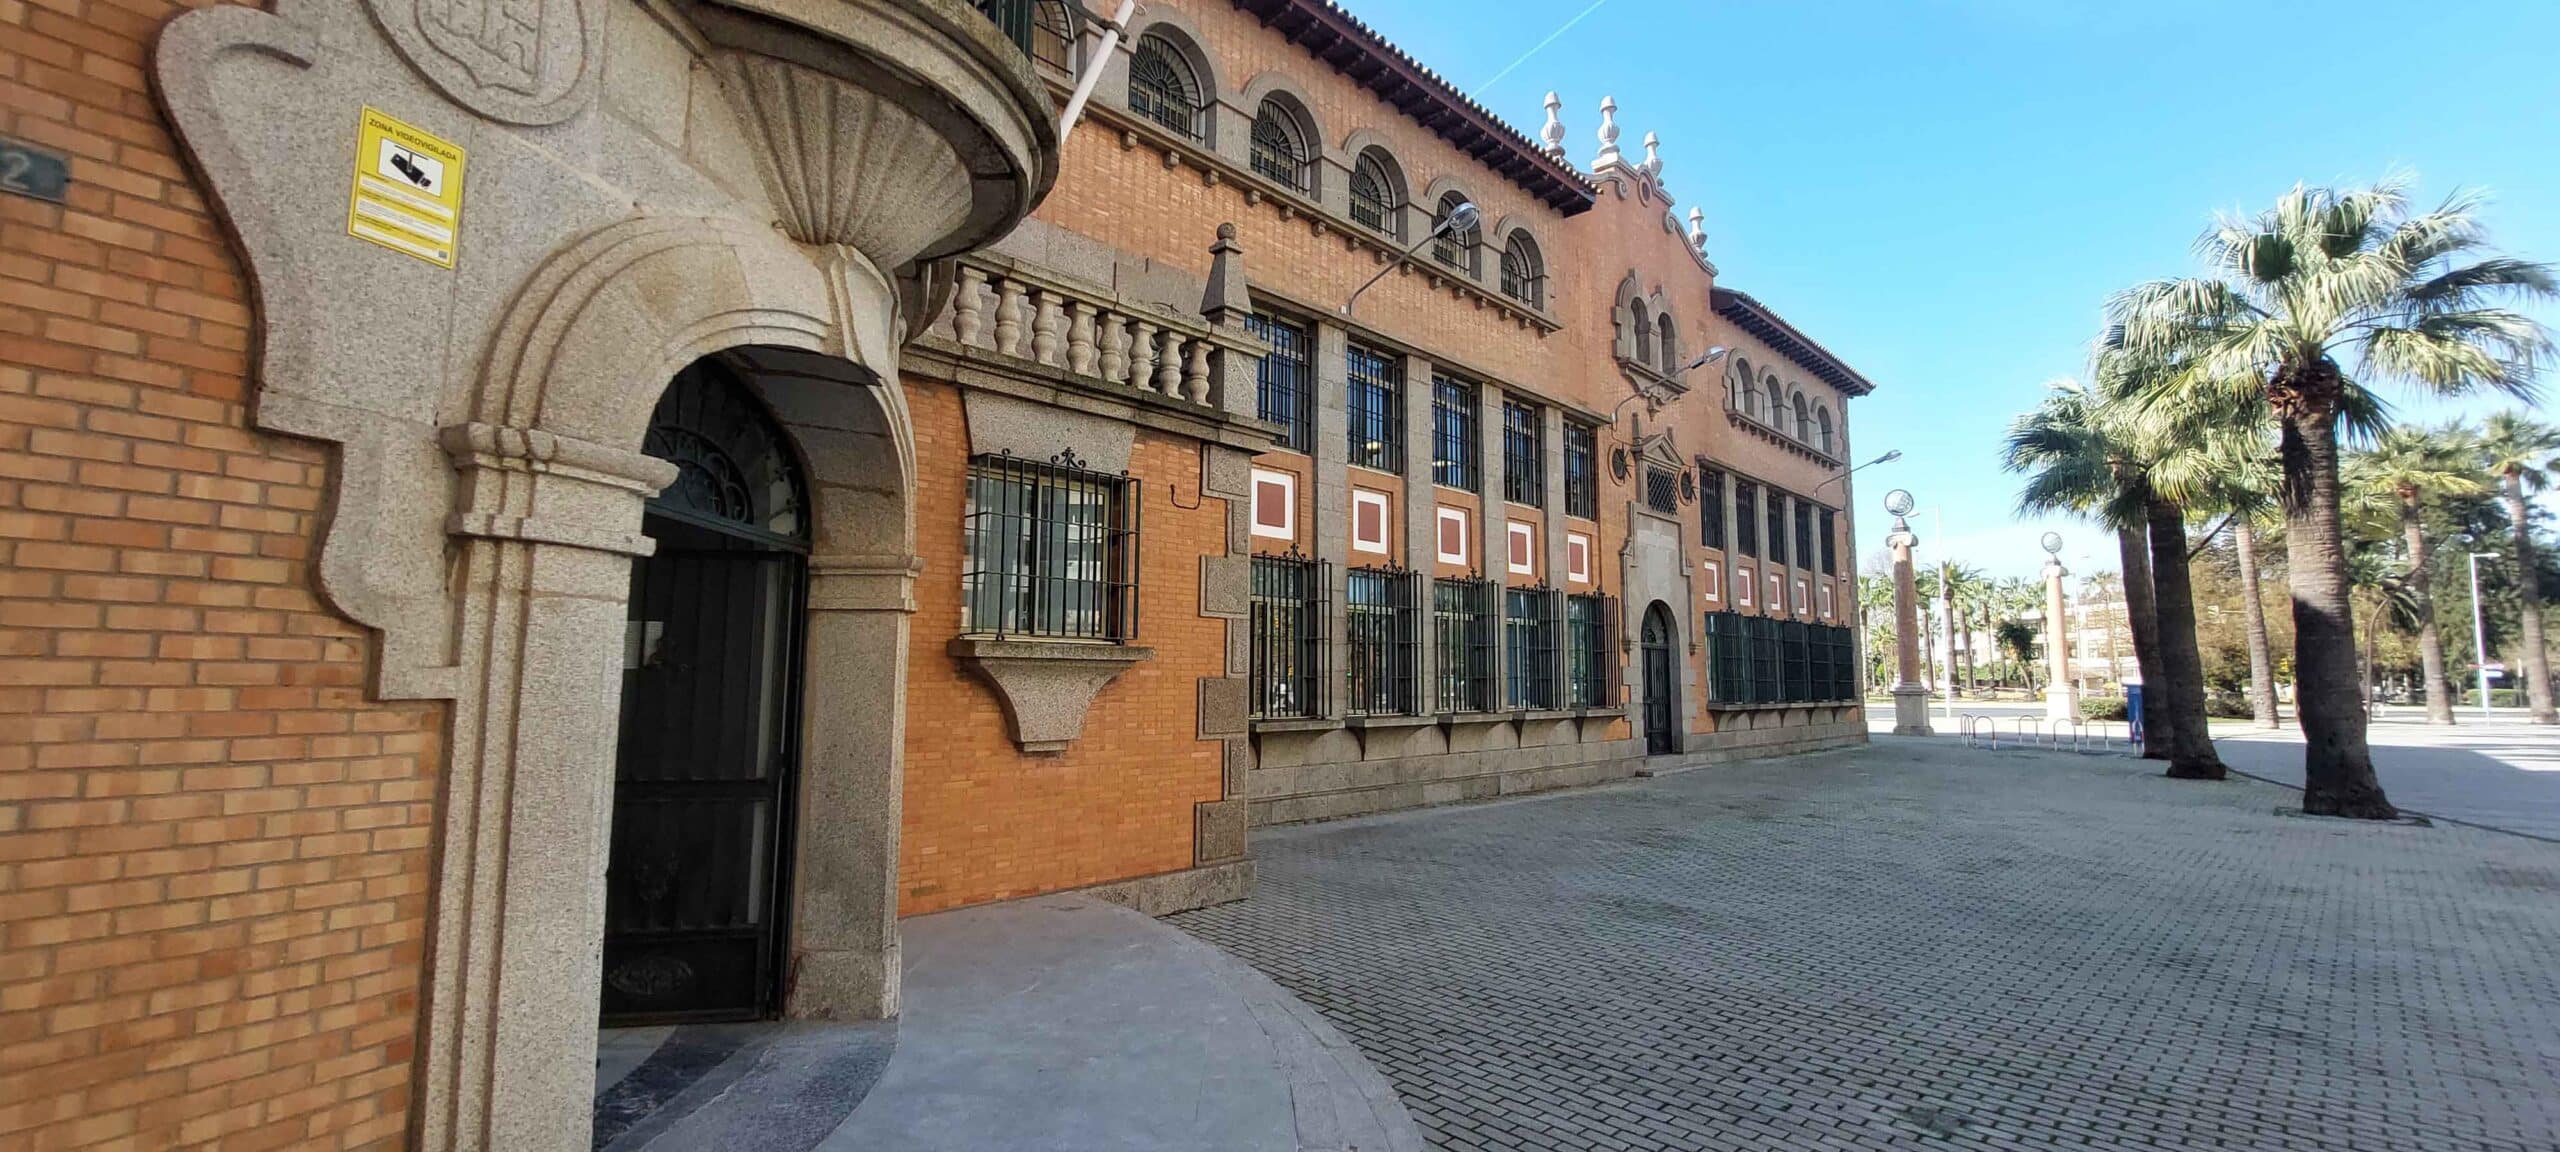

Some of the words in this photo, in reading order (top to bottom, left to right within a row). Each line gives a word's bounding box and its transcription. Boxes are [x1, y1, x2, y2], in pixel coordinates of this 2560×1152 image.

[369, 118, 394, 134] ZONA
[396, 130, 457, 161] VIDEOVIGILADA
[3, 151, 31, 191] 2
